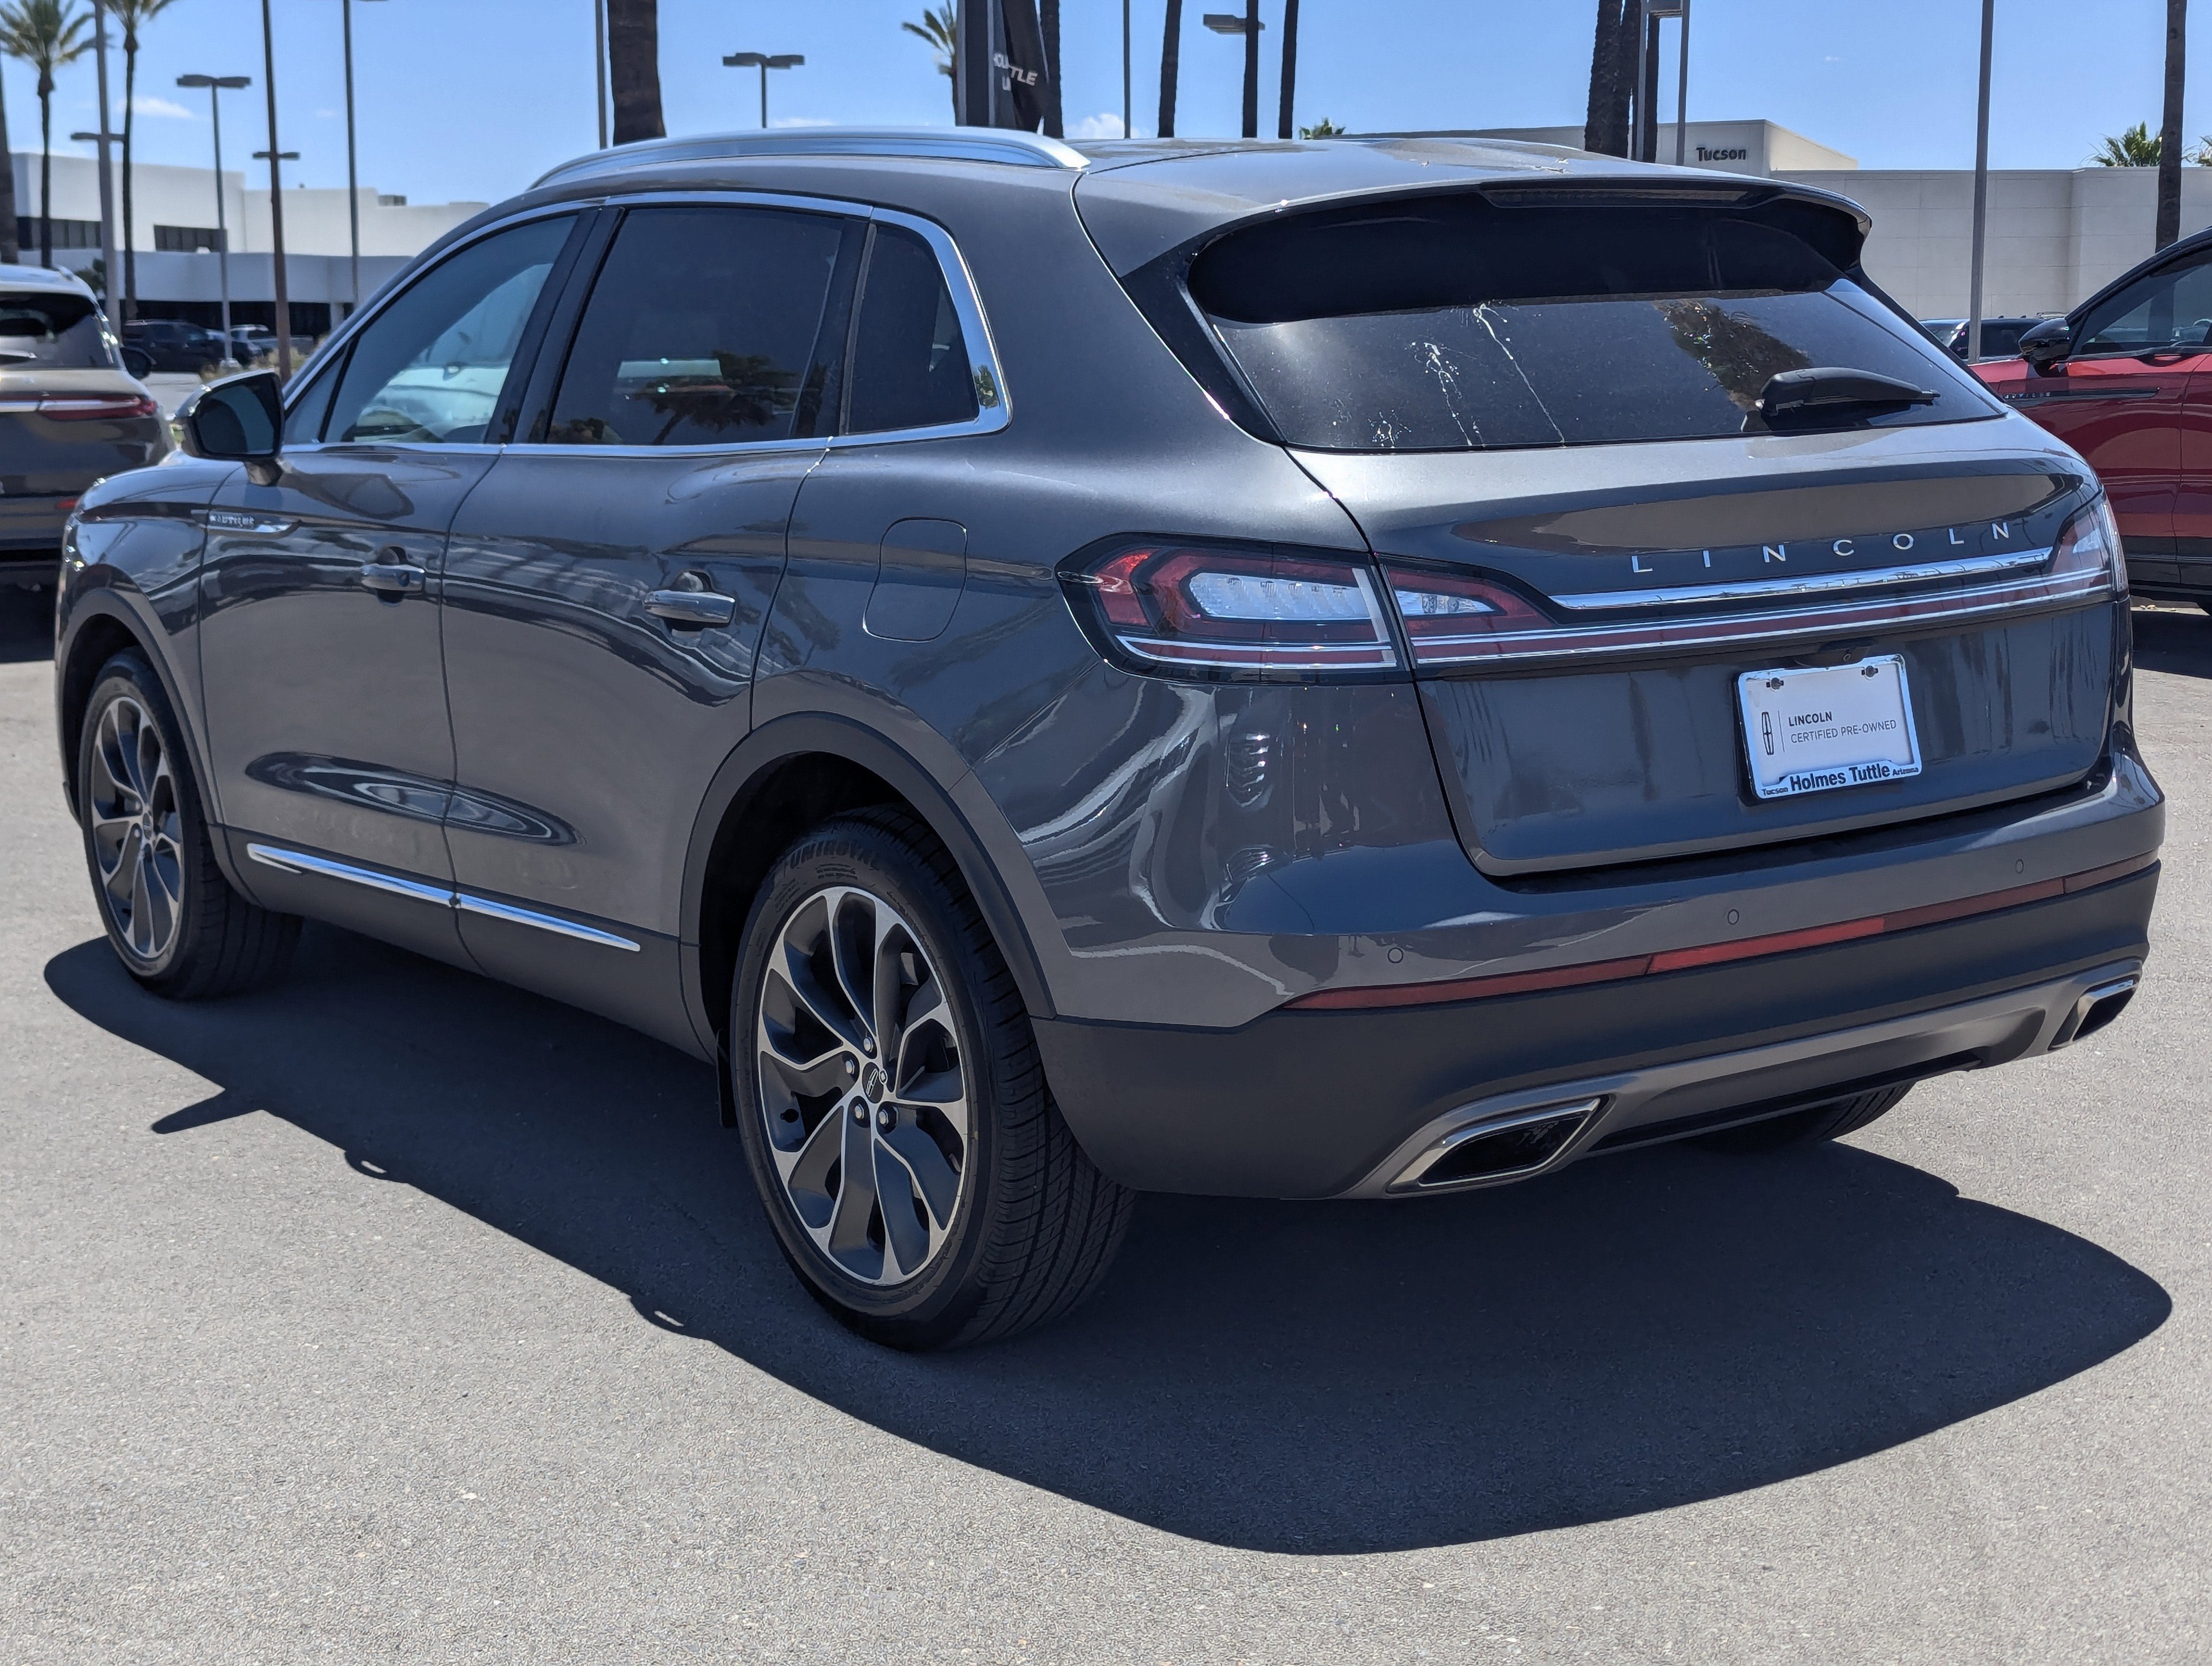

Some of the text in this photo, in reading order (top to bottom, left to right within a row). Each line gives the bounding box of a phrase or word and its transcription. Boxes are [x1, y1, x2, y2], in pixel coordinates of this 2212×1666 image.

[1696, 146, 1746, 162] Tucson
[1632, 521, 2010, 573] LINCOLN
[1789, 711, 1832, 727] LINCOLN
[1791, 719, 1897, 744] CERTIFIED PRE-OWNED
[1790, 771, 1846, 792] Holmes
[1849, 763, 1890, 782] Tuttle
